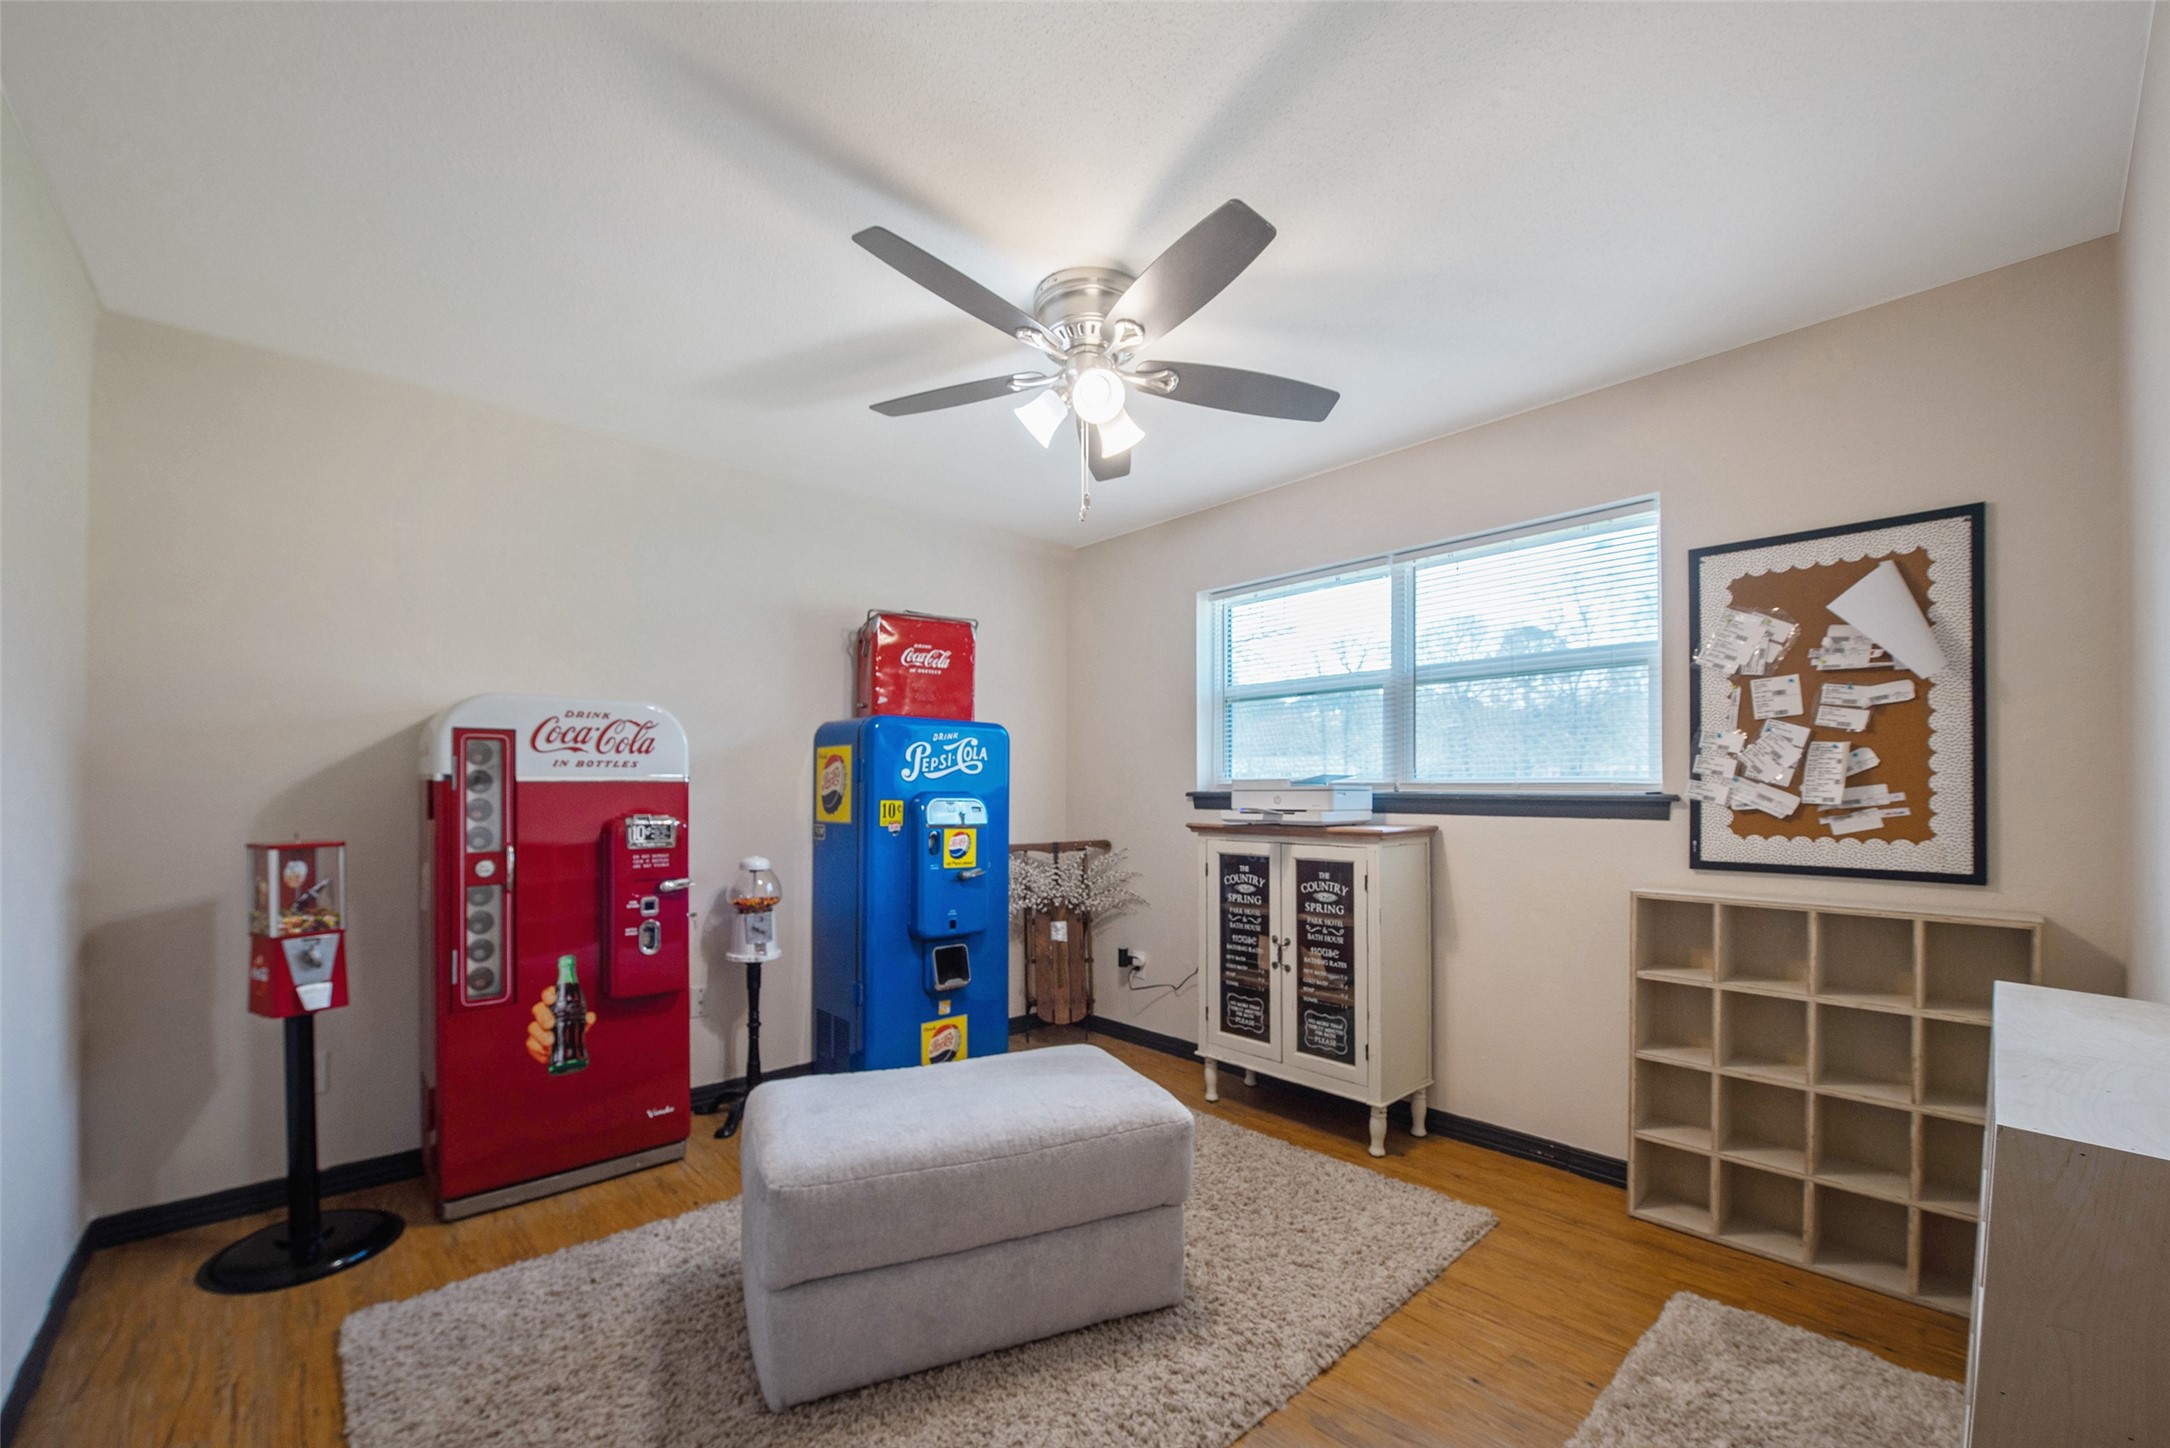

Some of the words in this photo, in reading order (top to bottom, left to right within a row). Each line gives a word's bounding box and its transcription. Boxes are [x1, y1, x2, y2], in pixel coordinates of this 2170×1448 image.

[901, 647, 952, 669] Coca-Cola
[564, 710, 611, 720] DRINK
[530, 716, 659, 755] Coca-Cola
[932, 732, 959, 742] DRINK
[552, 759, 567, 768] IN
[575, 760, 639, 768] BOTTLES
[1224, 873, 1266, 888] COUNTRY
[1318, 872, 1330, 880] THE
[1300, 880, 1349, 896] COUNTRY
[1227, 893, 1262, 905] SPRING
[1304, 901, 1345, 915] SPRING
[1229, 922, 1243, 930] BATH
[1244, 923, 1261, 932] HOUSE
[1307, 917, 1323, 925] PARK
[1324, 918, 1344, 927] HOTEL
[1307, 933, 1323, 941] BATH
[1324, 934, 1344, 944] HOUSE
[1329, 960, 1347, 969] RATES
[1235, 1016, 1255, 1026] PLEASE
[1314, 1036, 1337, 1047] PLEASE
